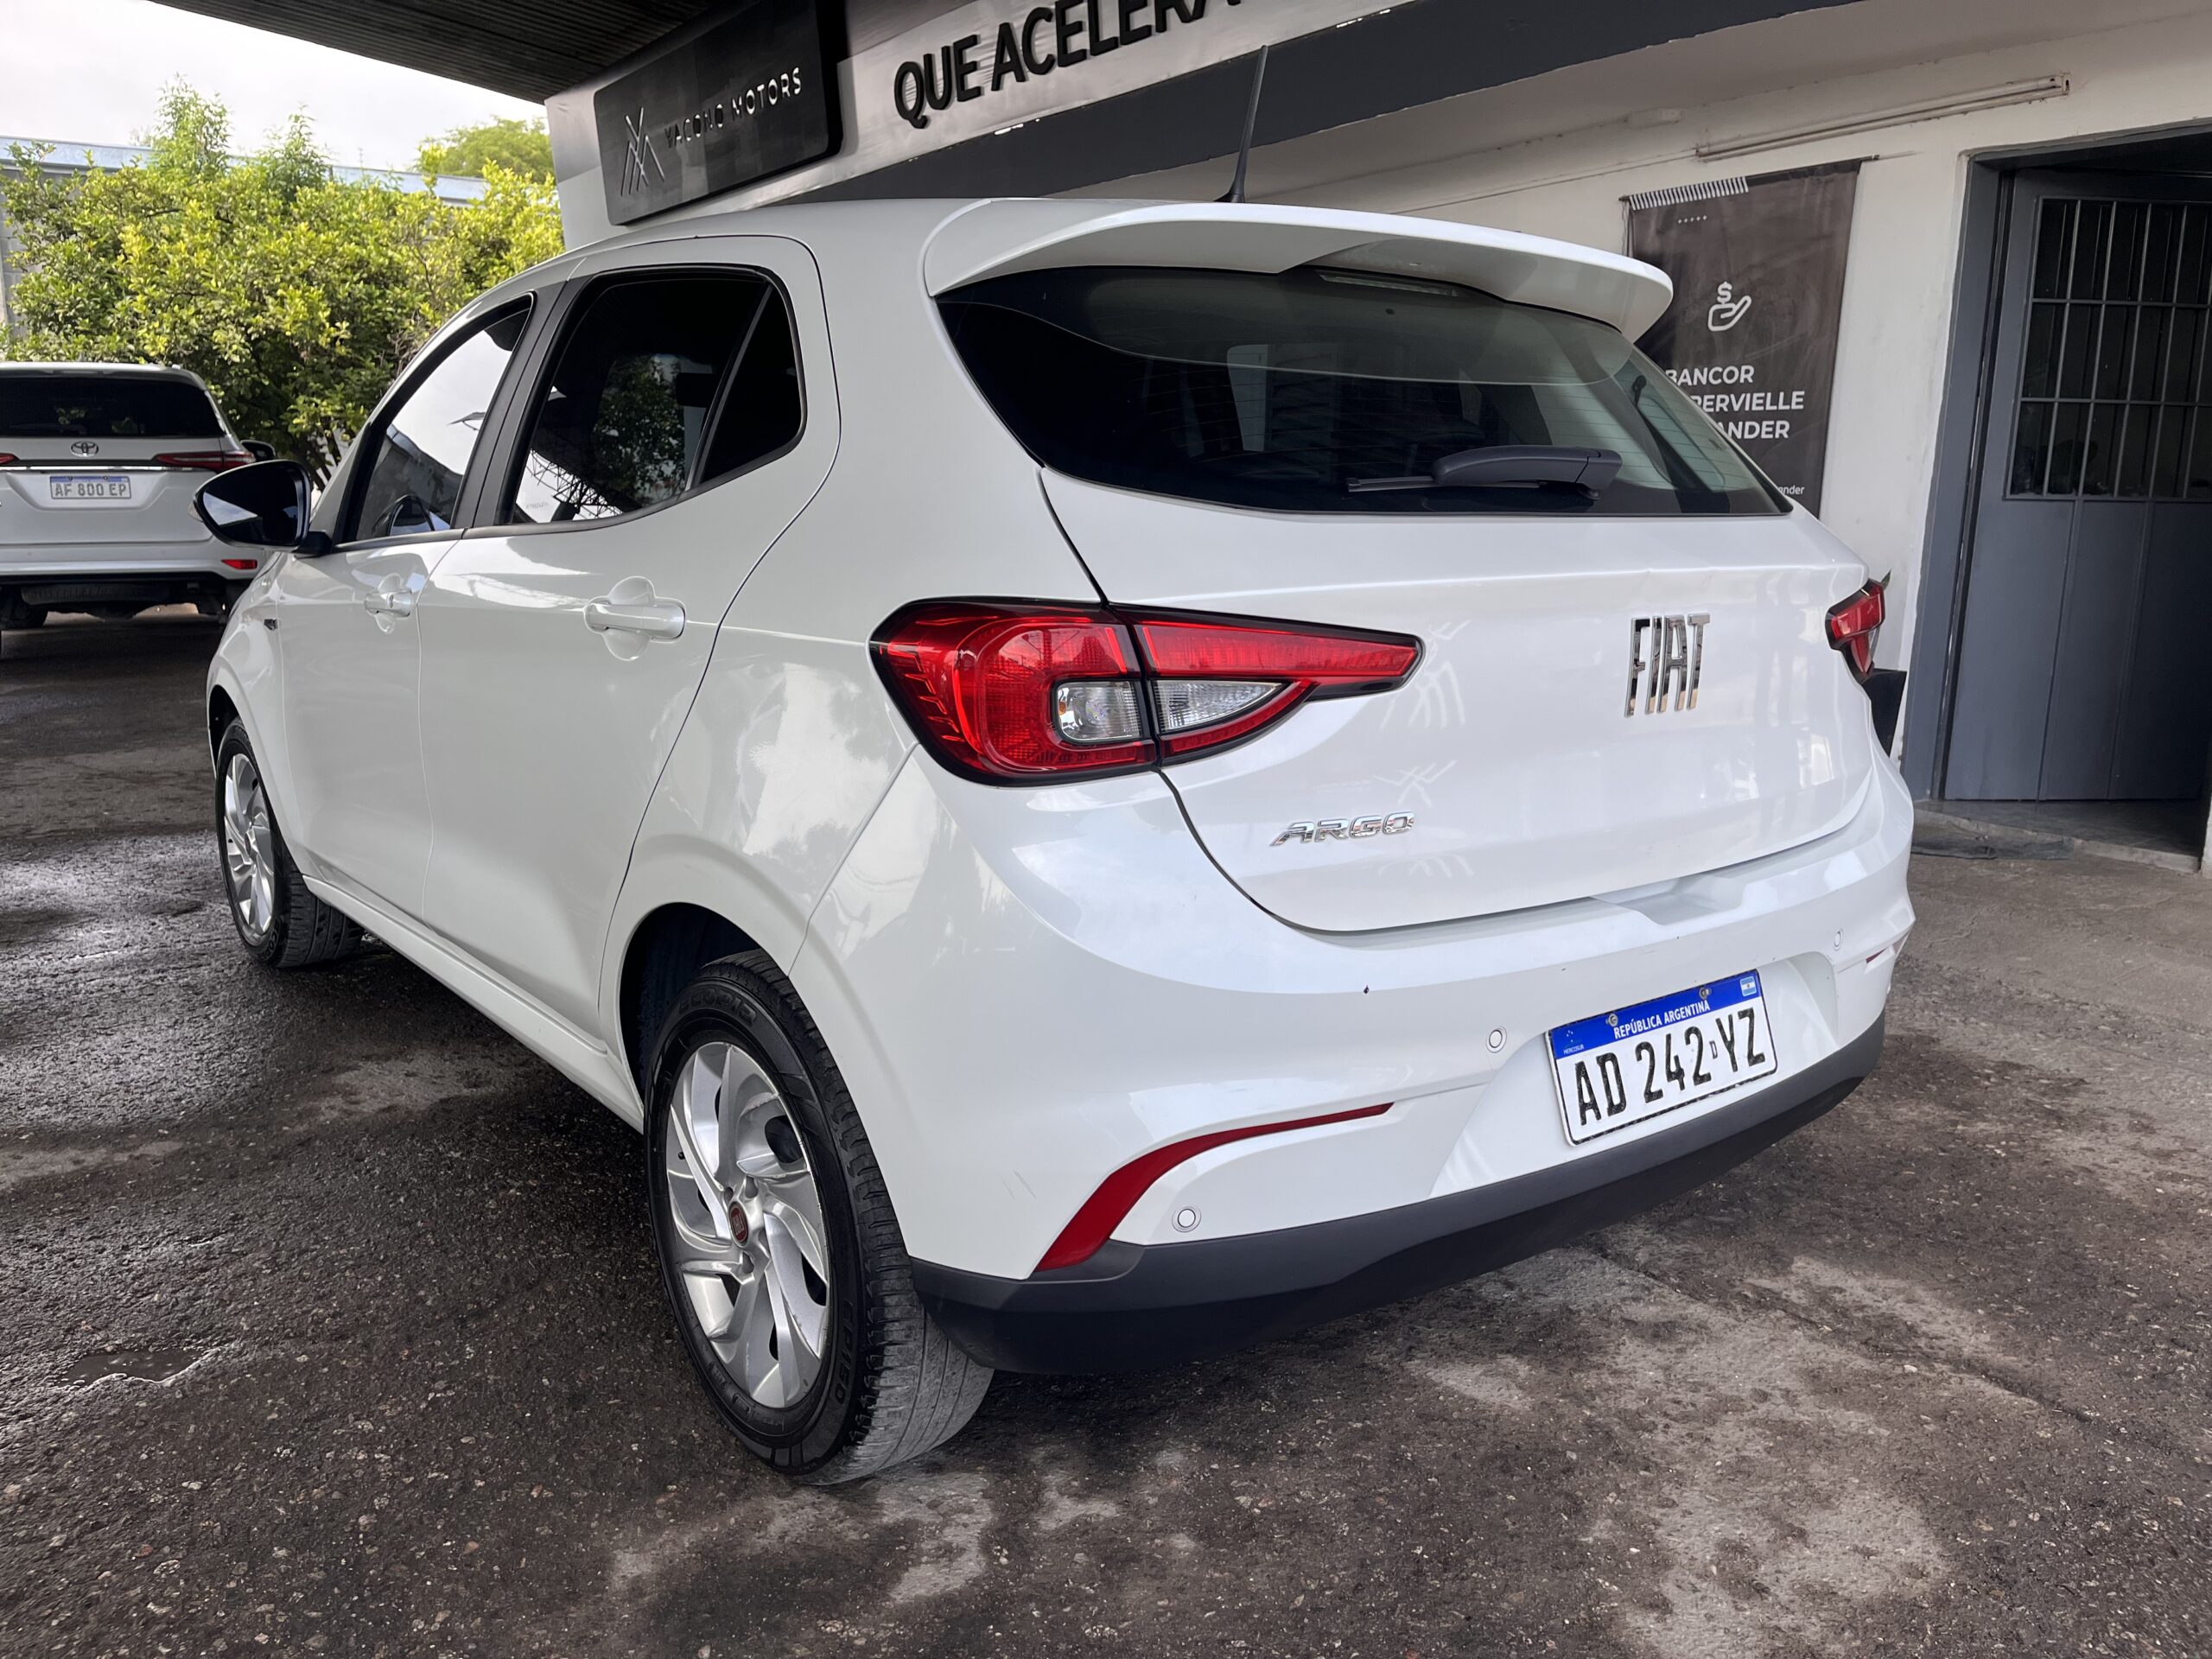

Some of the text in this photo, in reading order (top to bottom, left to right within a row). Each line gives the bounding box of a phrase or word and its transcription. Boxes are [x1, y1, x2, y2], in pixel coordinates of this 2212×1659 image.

[894, 0, 1241, 130] QUE ACELER
[664, 67, 802, 149] YACONO MOTORS
[1717, 420, 1790, 439] NDER
[55, 483, 126, 496] AF 800 EP
[1624, 613, 1711, 718] FIAT
[1269, 811, 1414, 847] ARGO
[1613, 1000, 1711, 1039] REPÚBLICA ARGENTINA
[1575, 1052, 1627, 1126] AD
[1635, 1026, 1712, 1103] 242
[1715, 1007, 1765, 1073] YZ
